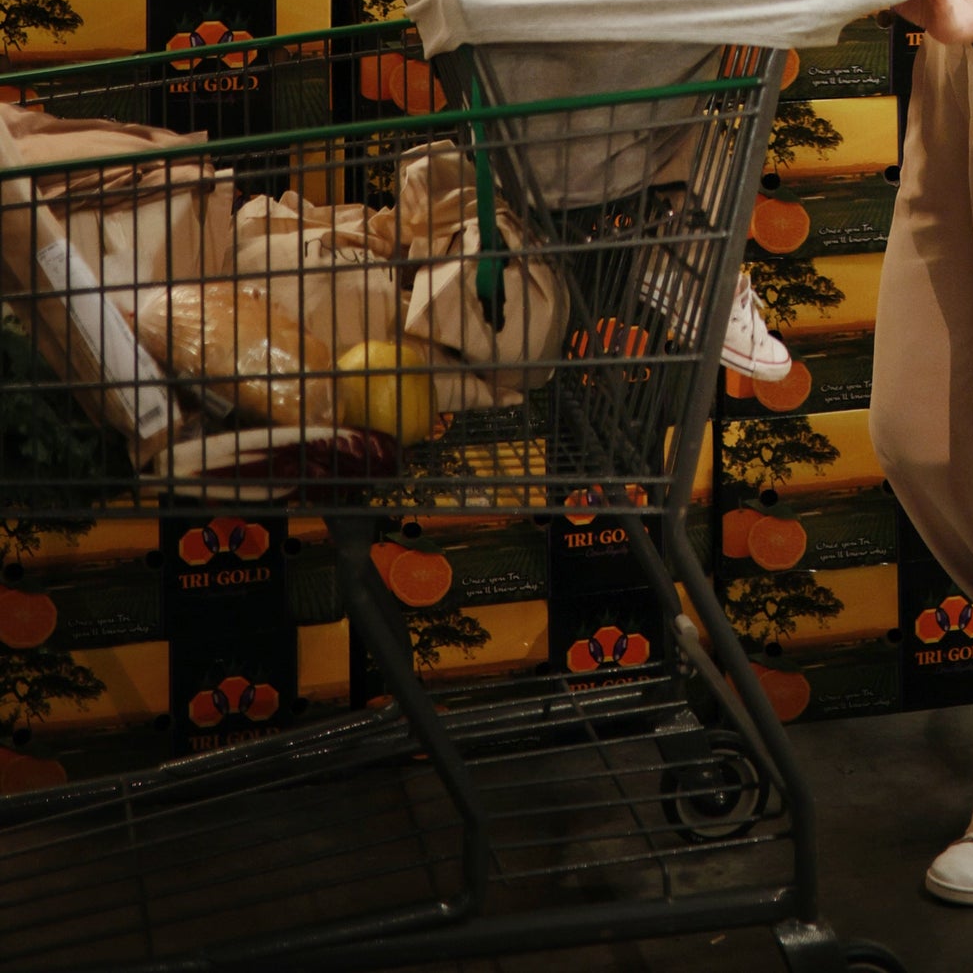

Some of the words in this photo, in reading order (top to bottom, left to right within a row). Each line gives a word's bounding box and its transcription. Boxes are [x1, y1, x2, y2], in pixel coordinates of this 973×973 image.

[203, 75, 258, 92] GOLD
[564, 531, 594, 547] TRI
[178, 572, 209, 589] TRI
[216, 567, 270, 586] GOLD
[915, 650, 942, 665] TRI
